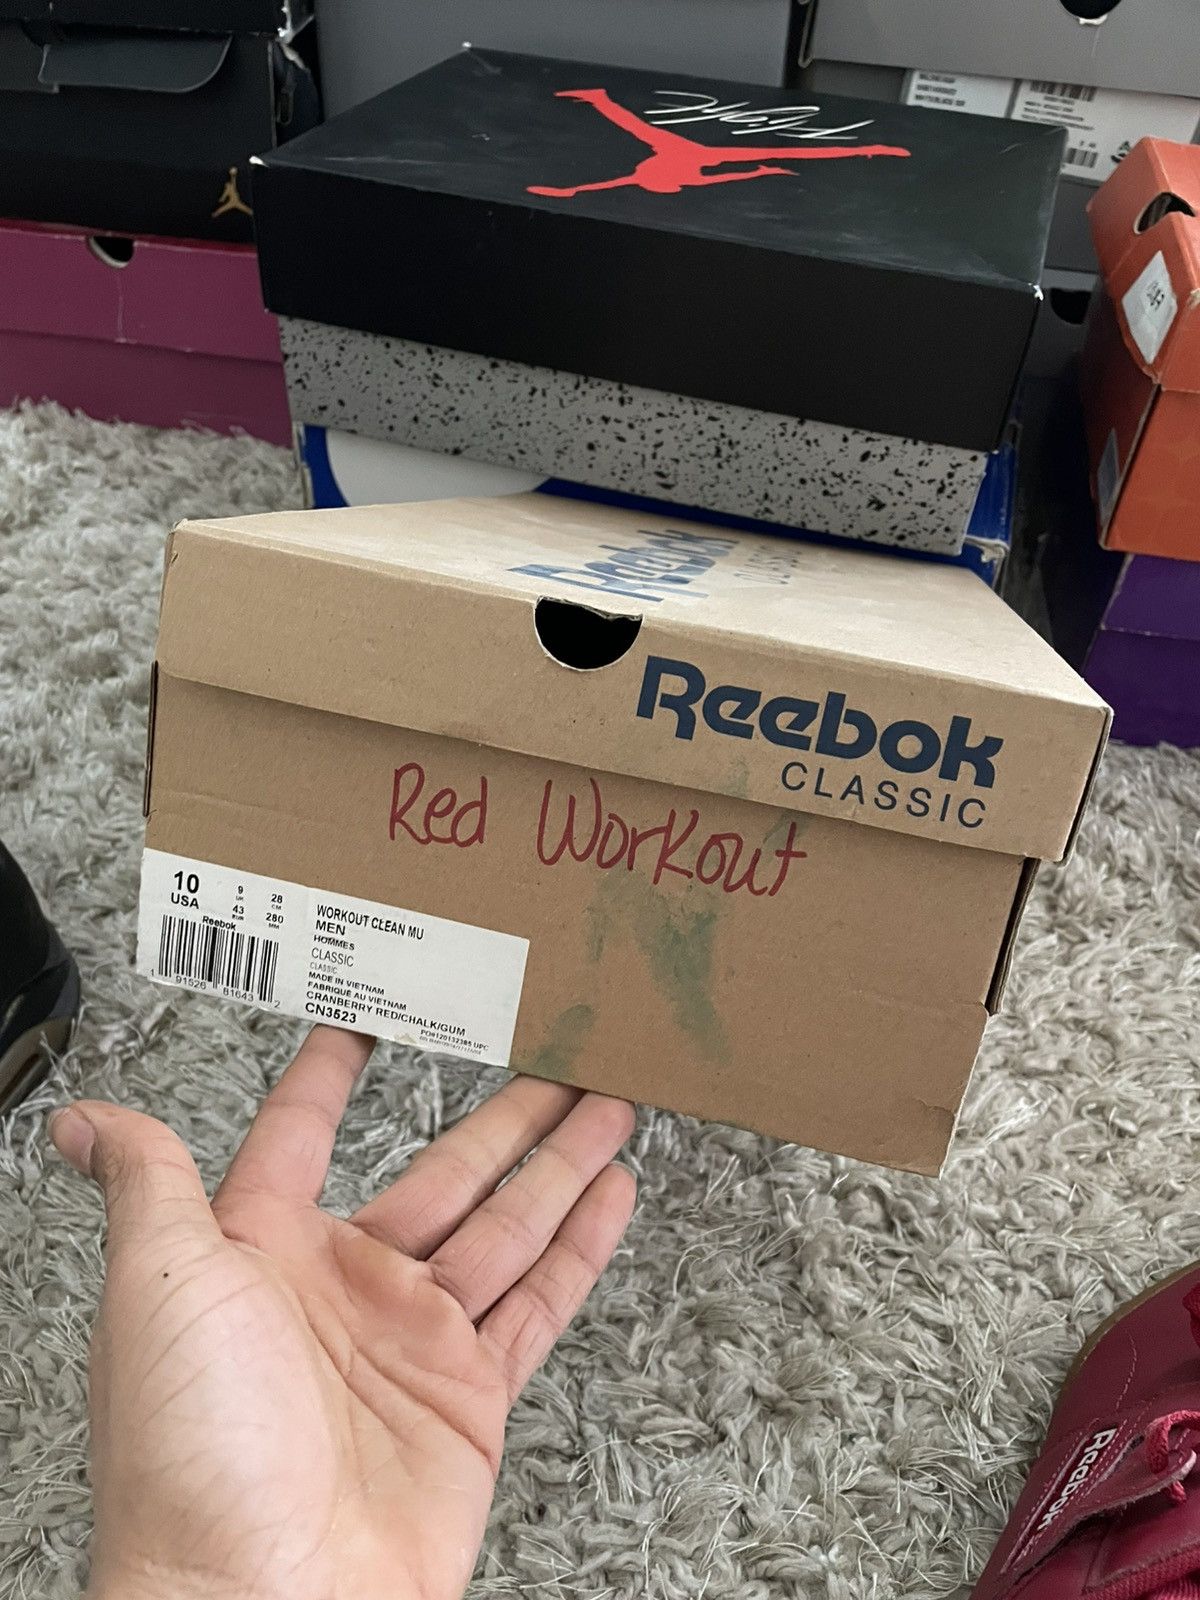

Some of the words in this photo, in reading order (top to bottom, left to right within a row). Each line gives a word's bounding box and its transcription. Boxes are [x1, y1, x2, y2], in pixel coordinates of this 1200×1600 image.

[636, 654, 1005, 790] Reebok
[389, 761, 489, 848] Red
[780, 761, 988, 829] CLASSIC
[174, 870, 200, 894] 10
[237, 885, 244, 895] 9
[170, 892, 200, 910] USA
[271, 893, 283, 904] 28
[232, 904, 245, 915] 43
[265, 912, 284, 924] 280
[202, 915, 237, 931] Reebok
[315, 919, 346, 936] MEN
[317, 904, 369, 927] WORKOUT
[371, 916, 406, 936] CLEAN
[408, 925, 424, 940] MU
[313, 934, 355, 951] HOMMES
[311, 947, 354, 967] CLASSIC
[309, 961, 338, 975] CLASSIC
[176, 975, 207, 990] 91526
[308, 971, 333, 983] MADE
[335, 977, 344, 986] IN
[346, 980, 385, 995] VIETNAM
[307, 981, 352, 997] FABRIQUE
[354, 992, 367, 1001] AU
[368, 995, 407, 1011] VIETNAM
[305, 1002, 357, 1024] CN3523
[306, 990, 373, 1013] CRANBERRY
[375, 1007, 466, 1037] RED/CHALK/GUM
[1037, 1427, 1118, 1531] Reebok
